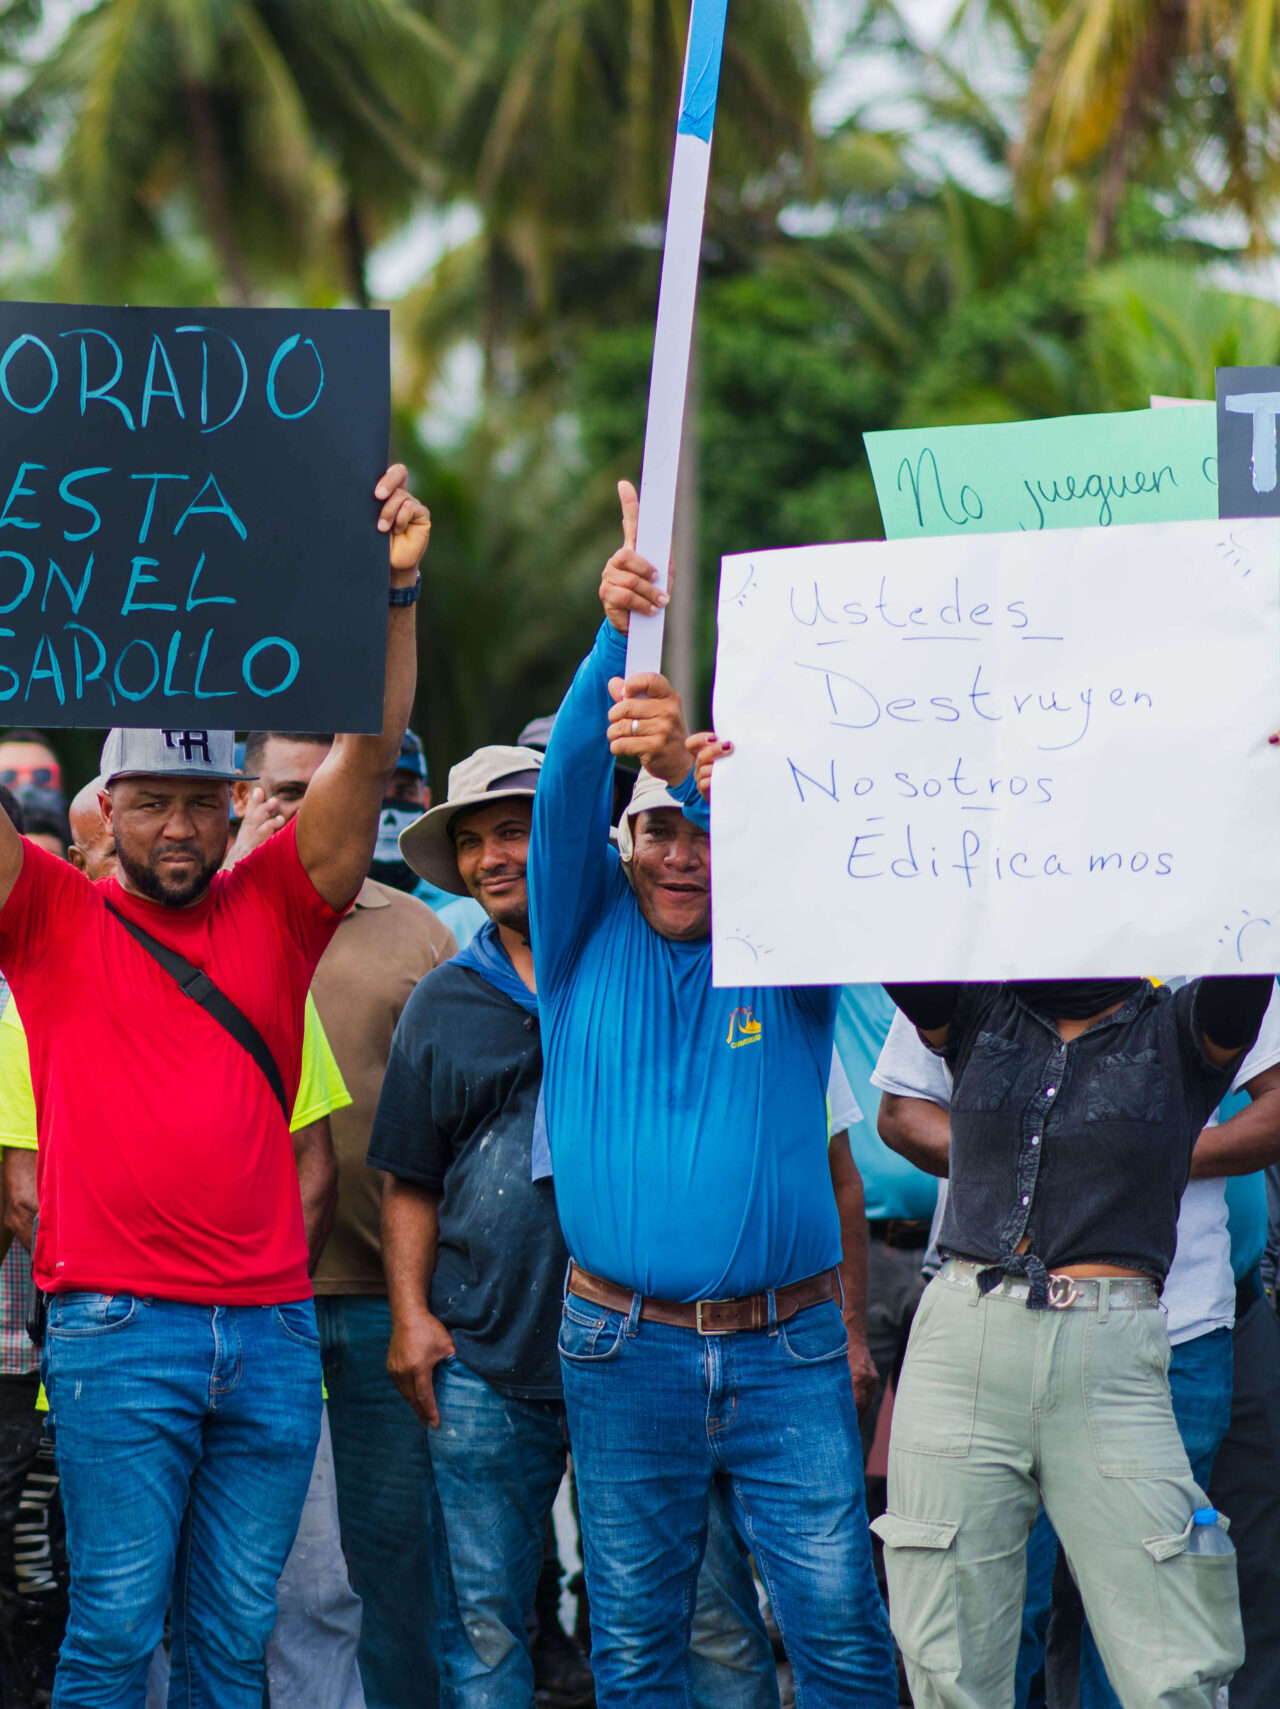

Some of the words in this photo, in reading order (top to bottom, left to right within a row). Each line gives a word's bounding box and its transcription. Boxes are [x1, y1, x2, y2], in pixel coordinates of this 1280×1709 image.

[896, 447, 983, 528] No
[1017, 466, 1179, 530] jueguen
[120, 550, 238, 617] EL
[790, 575, 1029, 630] Ustedes
[794, 661, 1154, 751] Destruyen
[786, 756, 1054, 805] Nosotros
[846, 823, 1174, 889] Edificamos
